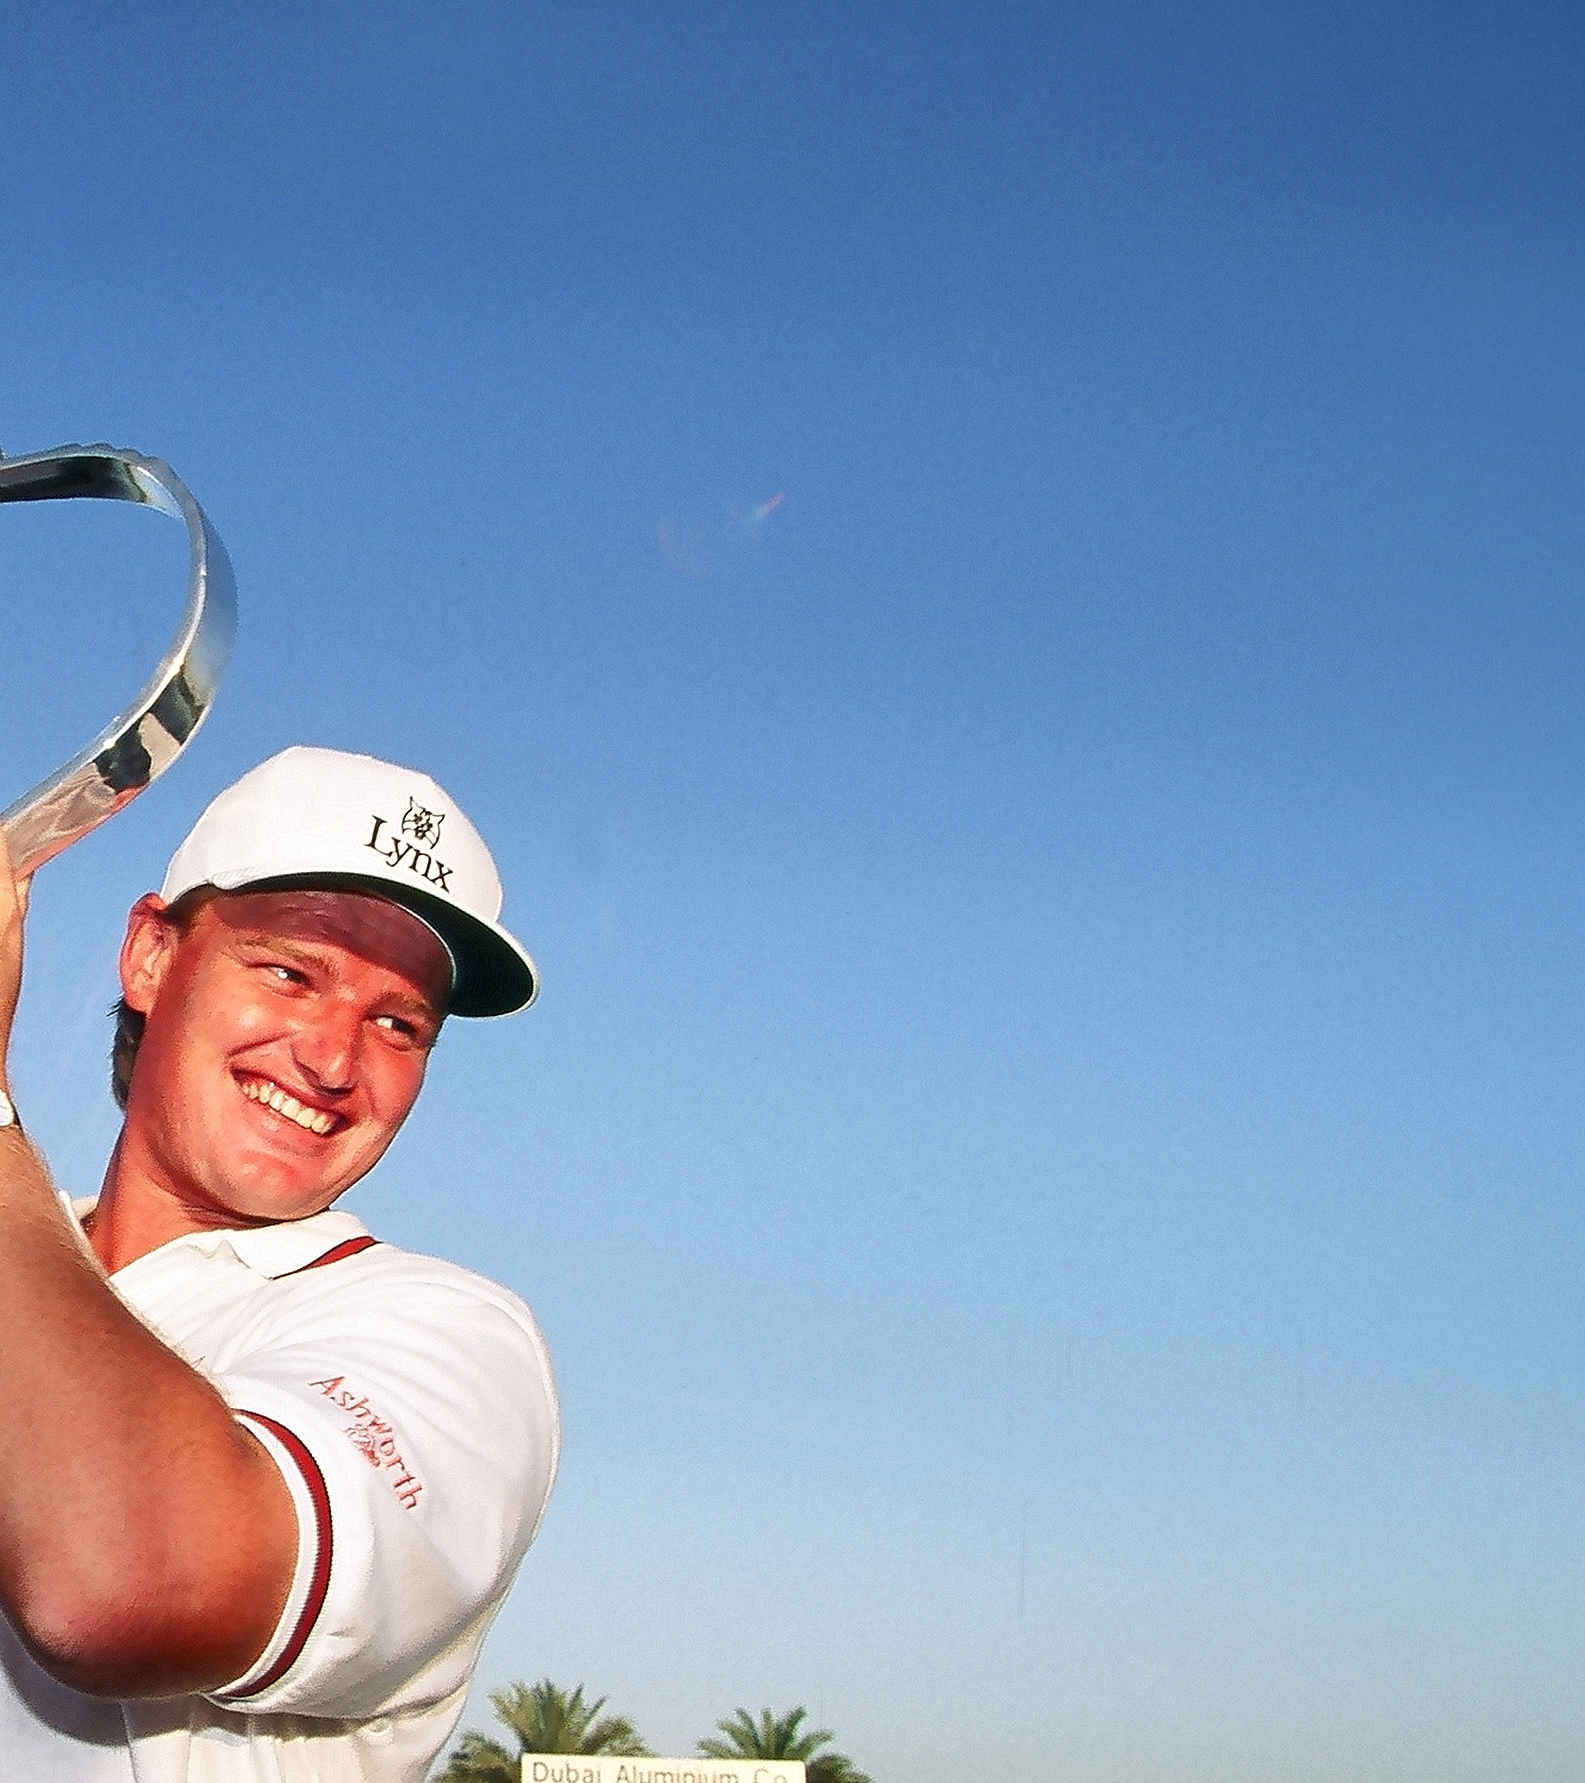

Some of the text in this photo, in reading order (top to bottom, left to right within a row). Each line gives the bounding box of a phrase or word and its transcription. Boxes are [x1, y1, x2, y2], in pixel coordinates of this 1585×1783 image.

[363, 815, 453, 893] Lynx
[308, 1376, 422, 1511] Ashworth
[533, 1761, 601, 1783] Dubai
[617, 1764, 739, 1783] Aluminium
